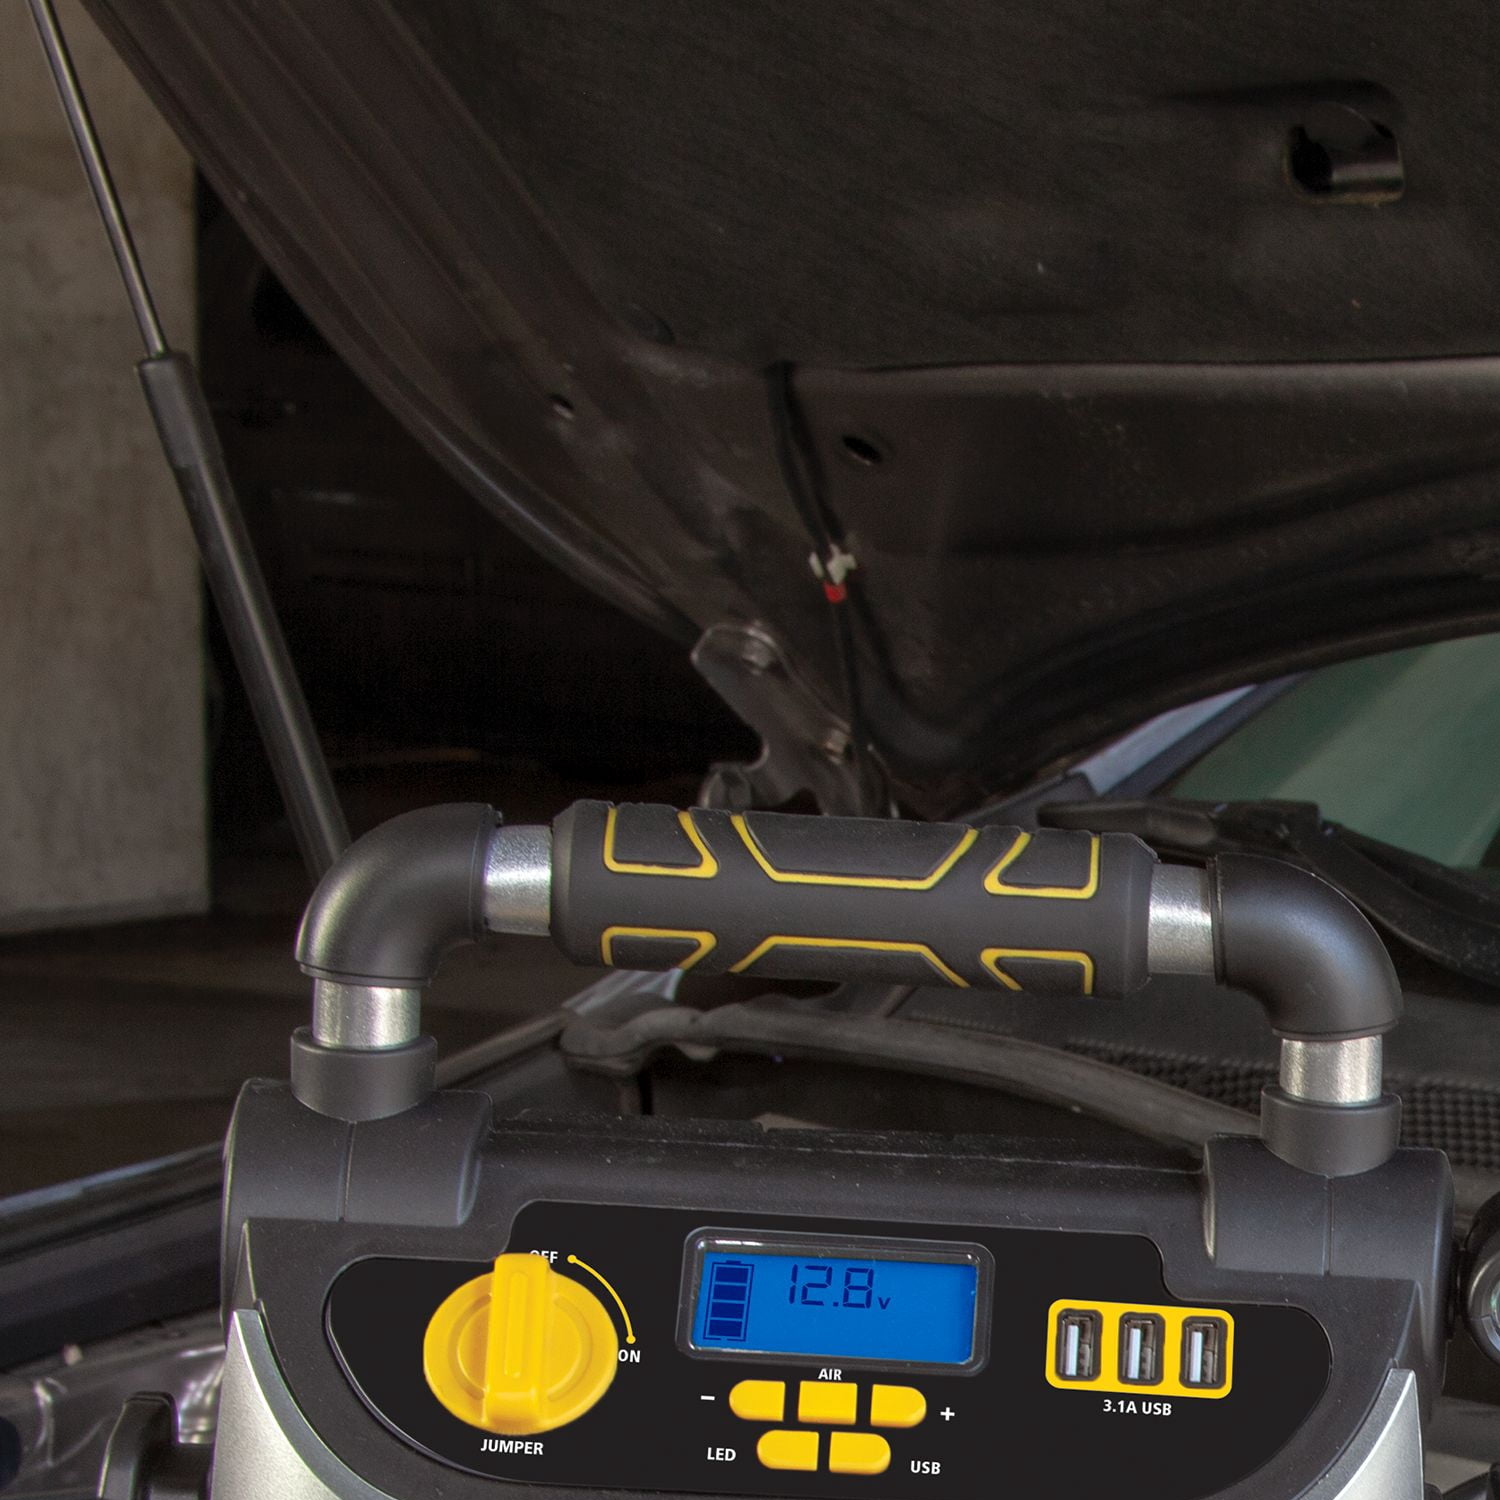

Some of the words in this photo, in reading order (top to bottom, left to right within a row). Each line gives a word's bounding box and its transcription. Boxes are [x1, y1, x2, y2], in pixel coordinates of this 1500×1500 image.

[618, 1350, 640, 1362] ON
[818, 1368, 841, 1380] AIR
[1103, 1399, 1137, 1413] 3.1A
[1142, 1402, 1171, 1415] USB
[481, 1439, 543, 1455] JUMPER
[707, 1447, 736, 1461] LED
[911, 1461, 940, 1474] USB
